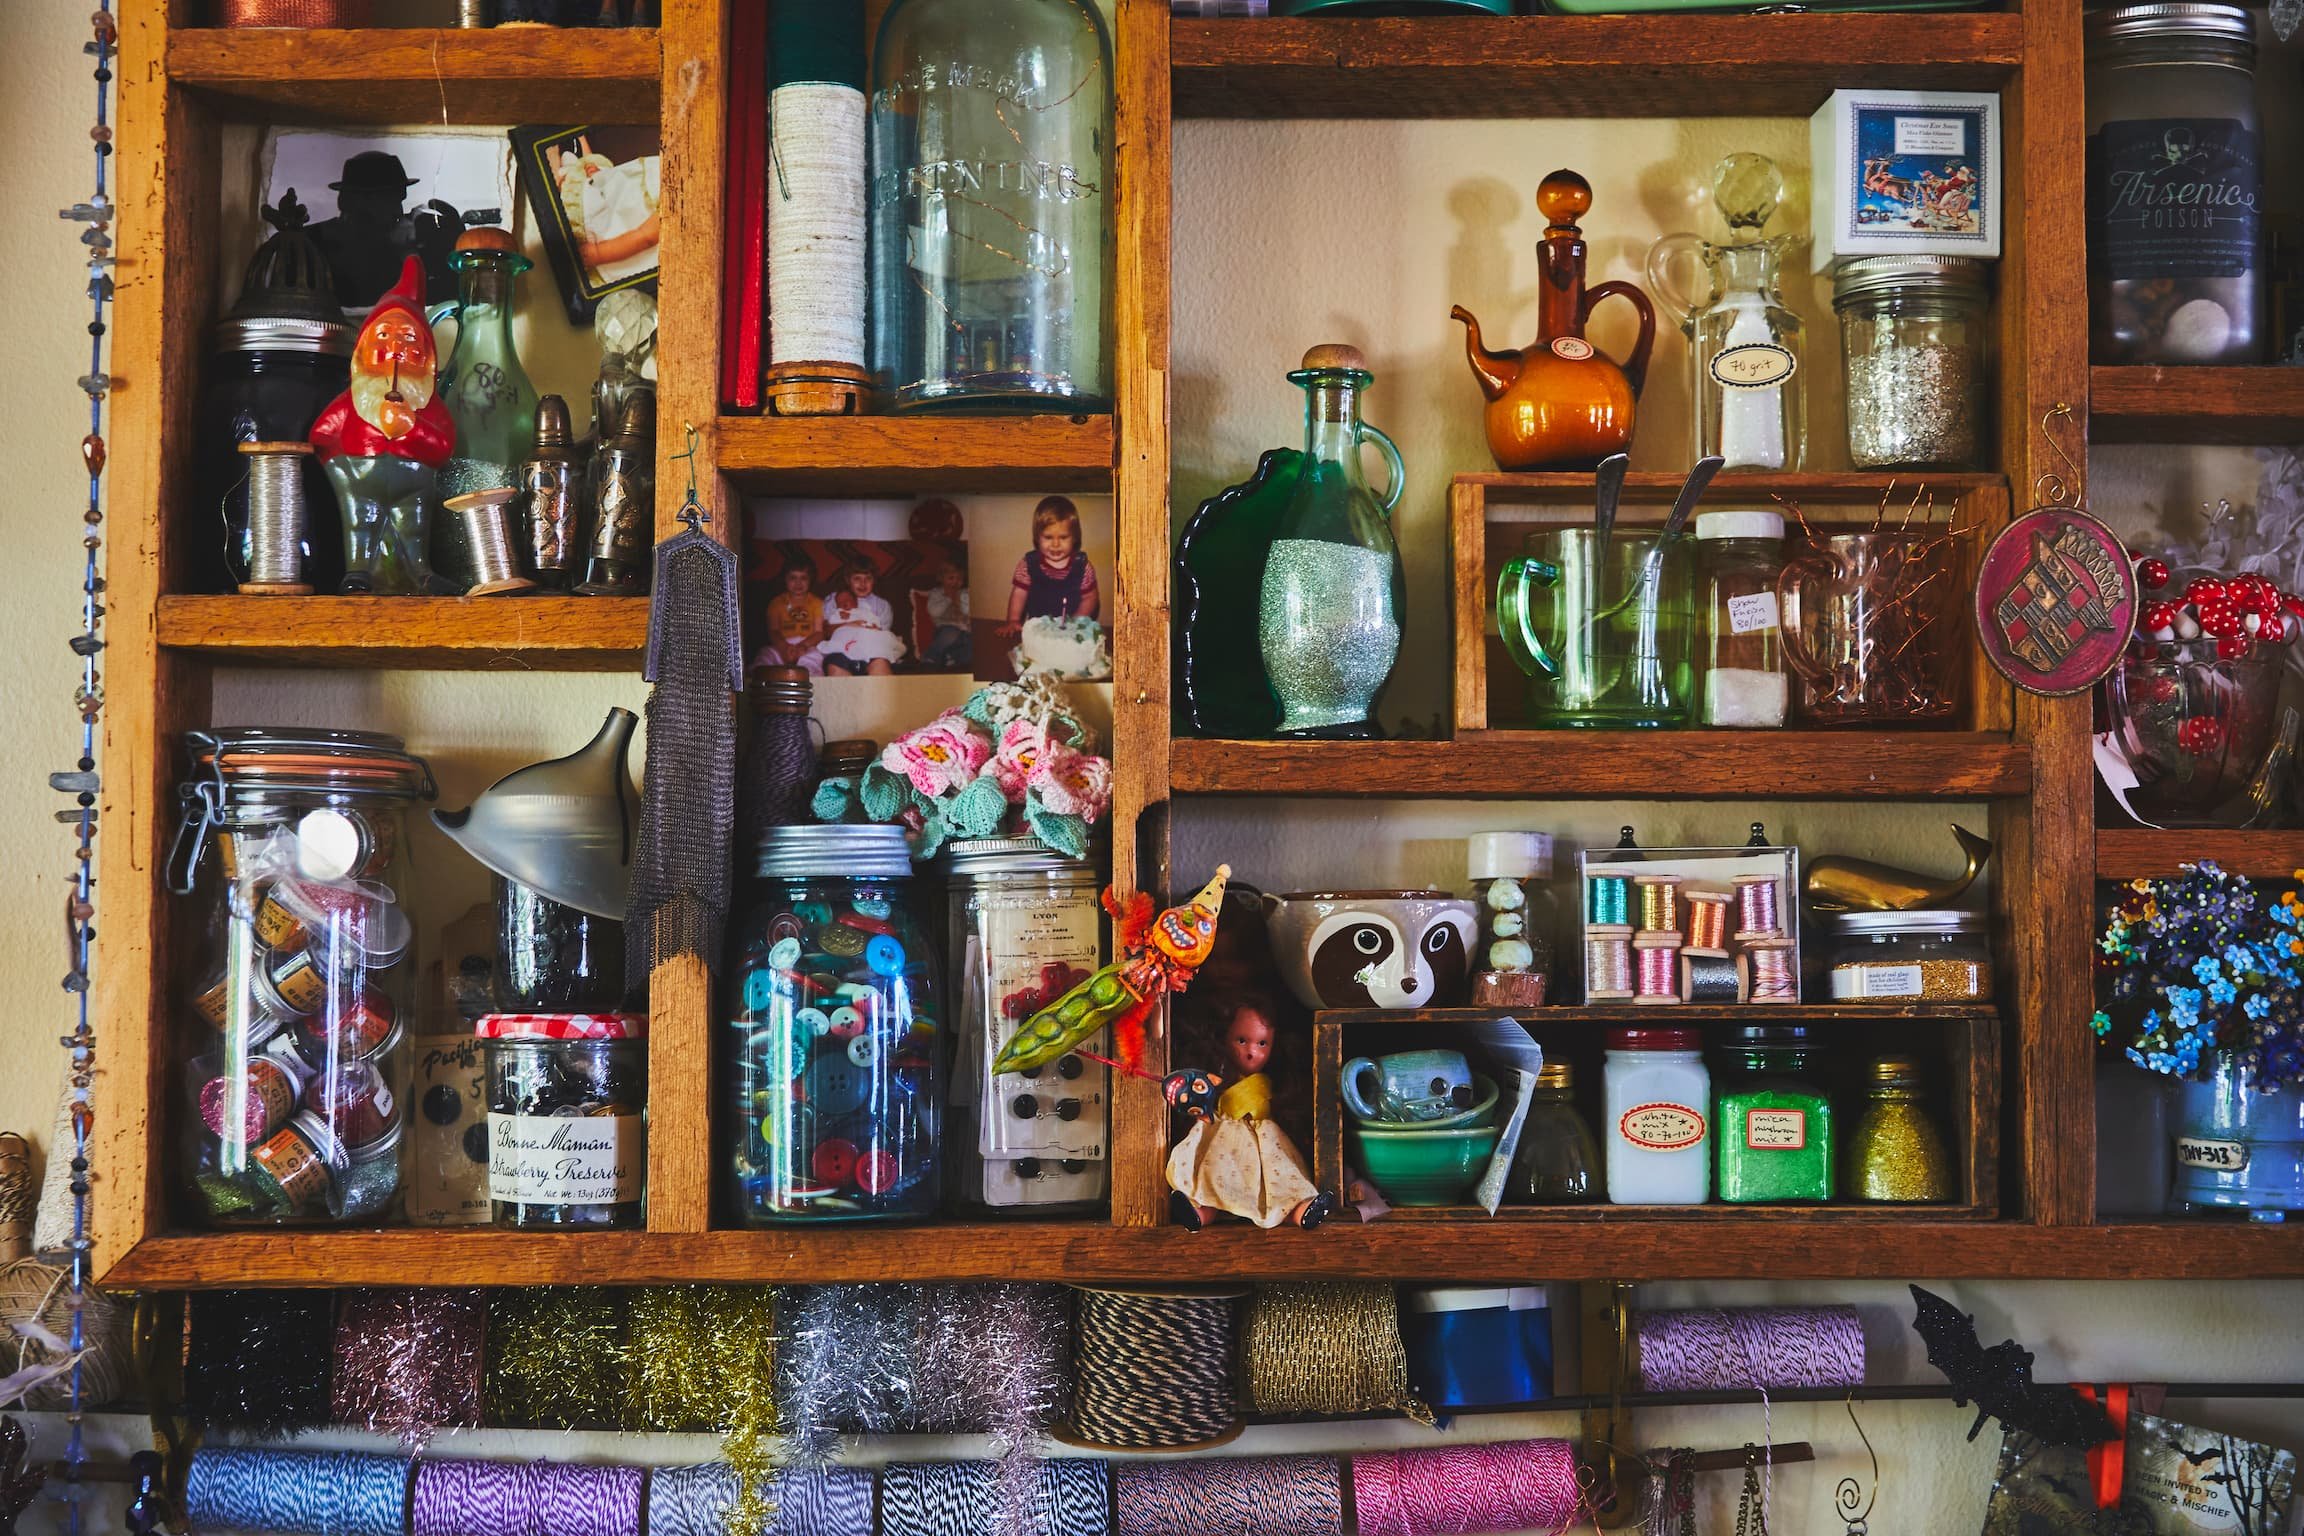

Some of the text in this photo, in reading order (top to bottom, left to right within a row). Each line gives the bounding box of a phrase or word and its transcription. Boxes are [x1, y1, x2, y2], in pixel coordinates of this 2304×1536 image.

[2106, 171, 2261, 216] Arsenic
[2141, 208, 2214, 229] POISON
[1730, 360, 1774, 377] 70 grit
[497, 1120, 613, 1151] Bonne Maman
[489, 1154, 627, 1188] Strawberry Preserves
[2135, 1470, 2218, 1499] BEEN INVITED TO
[2135, 1486, 2231, 1518] MAGIC & MISCHIEF
